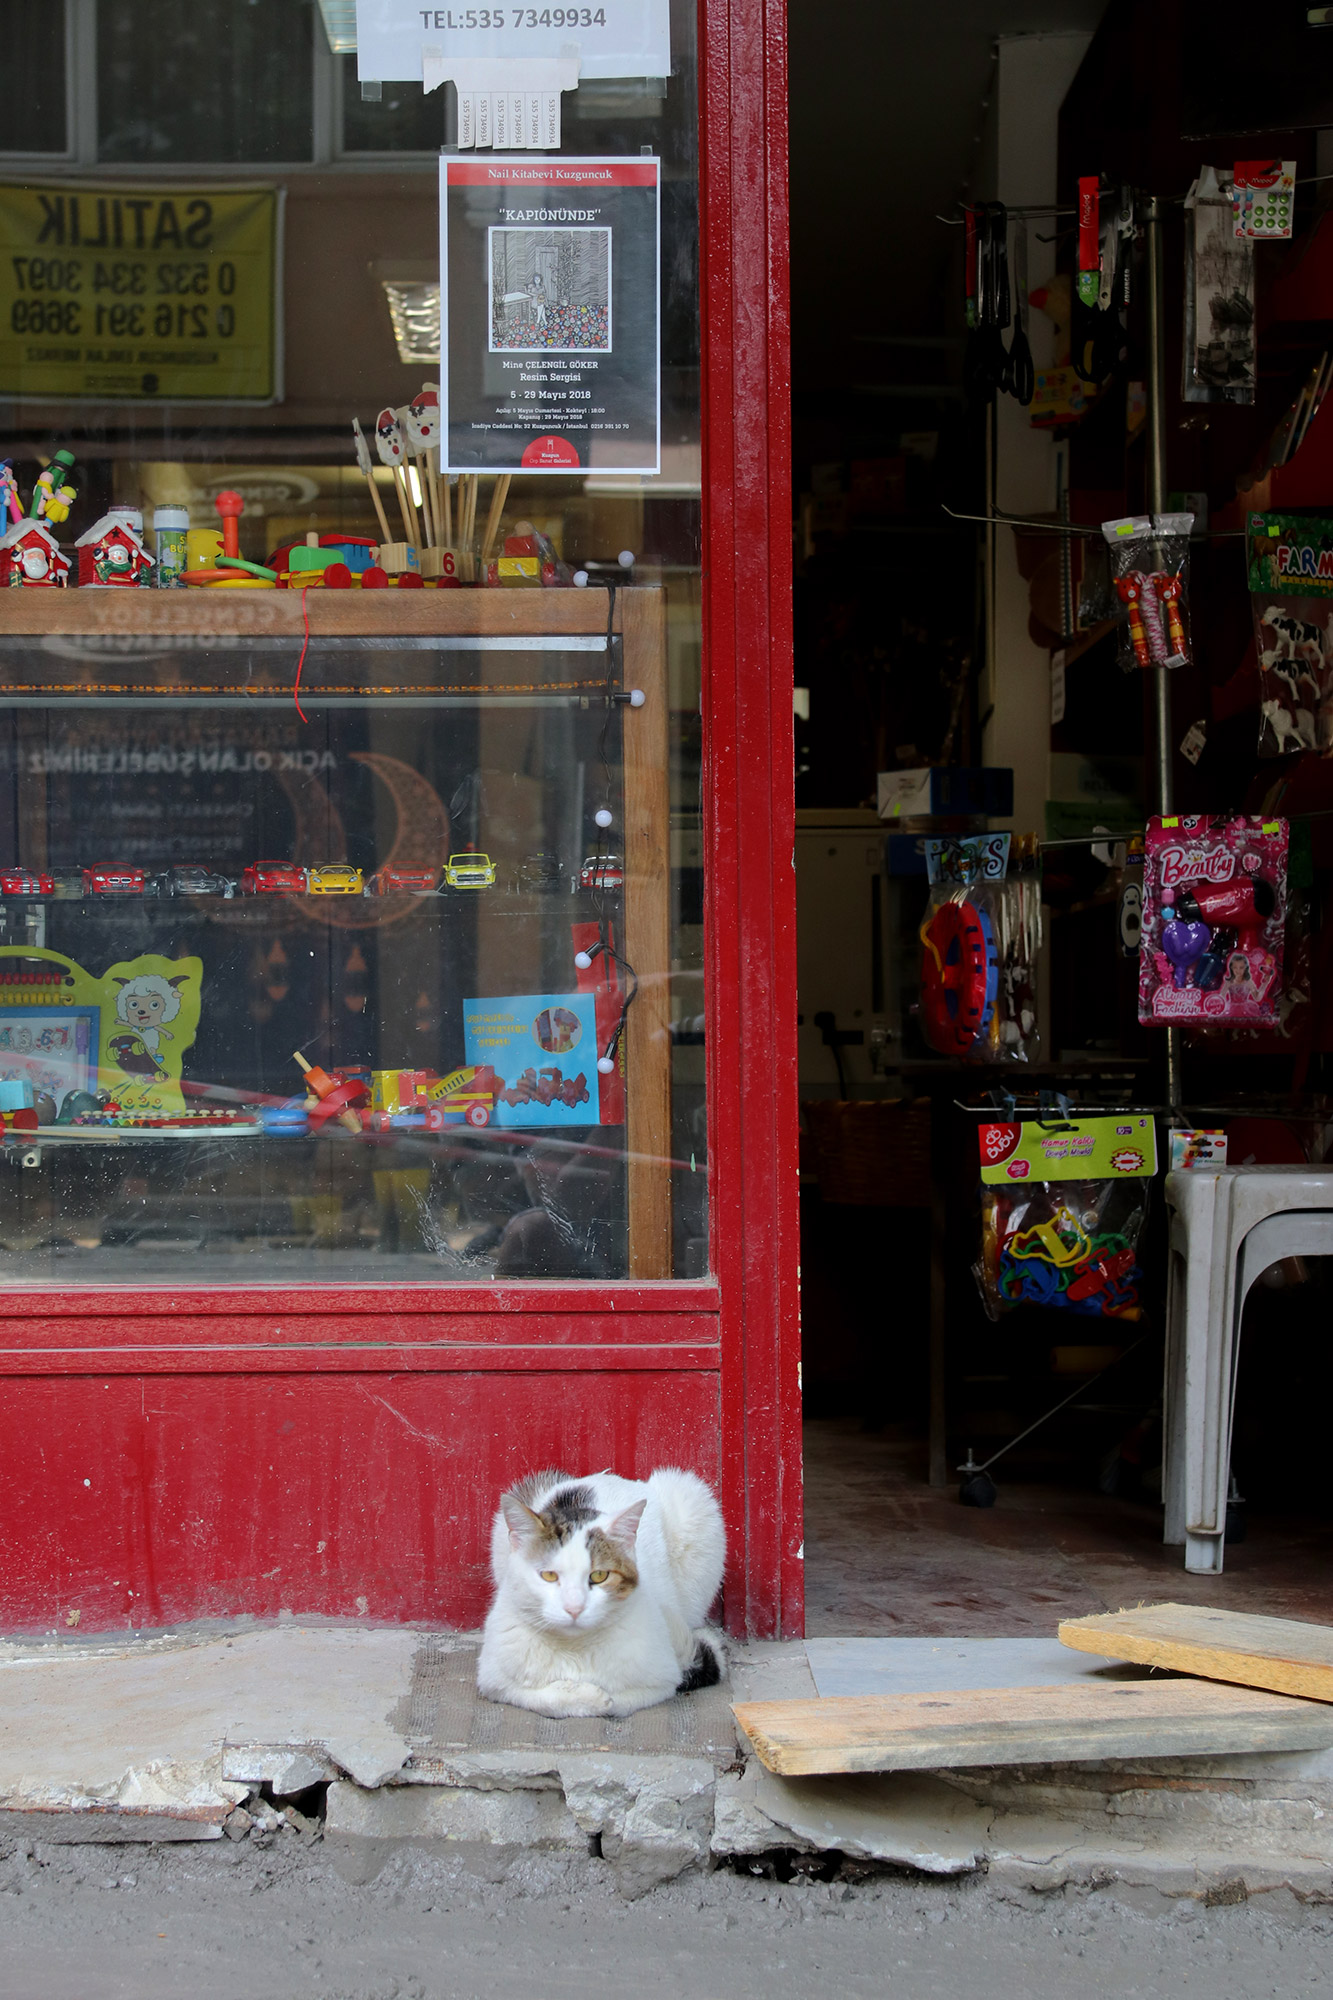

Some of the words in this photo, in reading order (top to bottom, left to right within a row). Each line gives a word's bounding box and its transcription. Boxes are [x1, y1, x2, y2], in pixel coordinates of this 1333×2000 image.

[419, 9, 505, 30] TEL:535
[511, 8, 607, 28] 7349934
[480, 100, 488, 112] 535
[514, 99, 522, 112] 535
[548, 99, 556, 112] 535
[480, 114, 488, 142] 7349934
[514, 114, 522, 143] 7349934
[548, 114, 556, 143] 7349934
[488, 169, 509, 179] Nail
[512, 169, 553, 179] Kitabevi
[556, 169, 613, 181] Kuzguncuk
[1081, 194, 1091, 225] Maped
[502, 361, 524, 369] Mine
[525, 359, 568, 370] ÇELENGİL
[569, 359, 599, 369] GÖKER
[520, 373, 548, 381] Resim
[550, 373, 582, 383] Sergisi
[510, 391, 516, 399] 5
[524, 391, 536, 399] 29
[538, 391, 567, 401] Mayıs
[569, 391, 591, 399] 2018
[443, 552, 456, 575] 6
[1161, 845, 1235, 886] Beauty
[1154, 987, 1201, 1003] Always
[1154, 1003, 1201, 1016] Fashion
[986, 1129, 1015, 1160] BUBU
